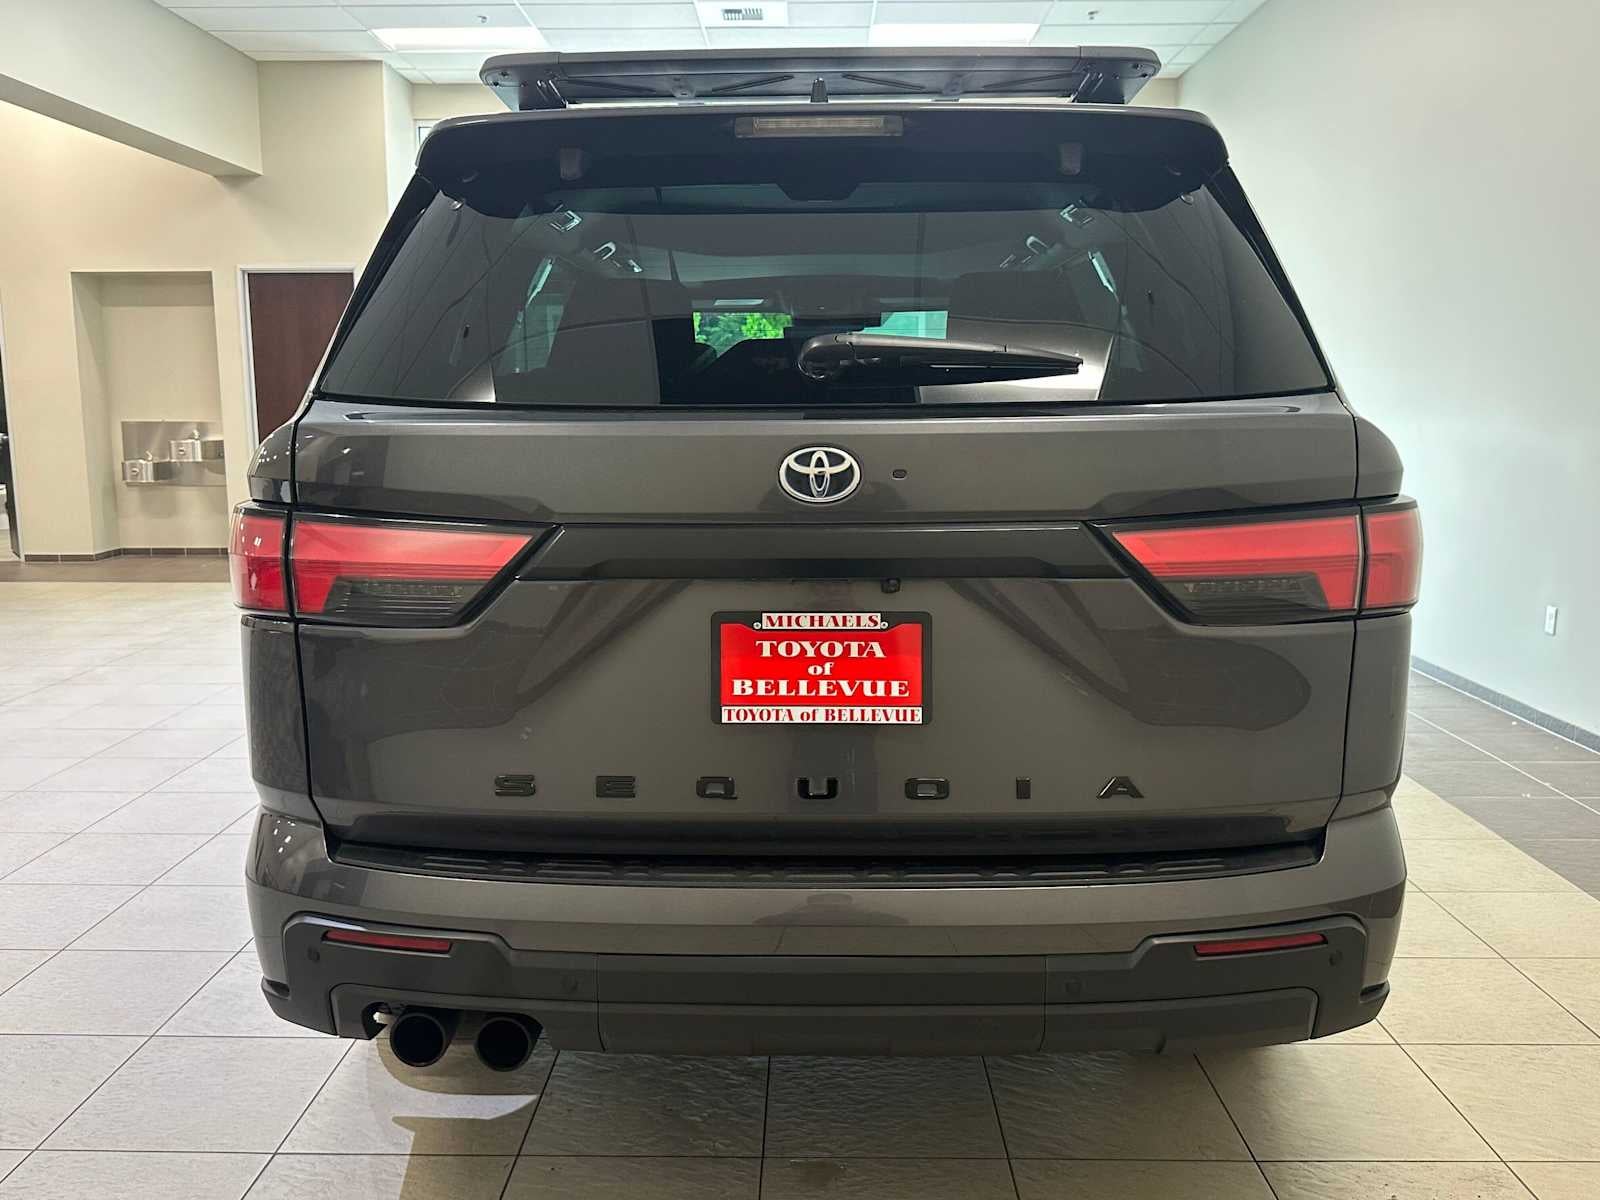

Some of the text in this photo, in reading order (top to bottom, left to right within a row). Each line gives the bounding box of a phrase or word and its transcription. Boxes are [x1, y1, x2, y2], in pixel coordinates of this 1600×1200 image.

[765, 615, 880, 628] MICHAELS
[755, 640, 887, 658] TOYOTA
[807, 662, 835, 676] of
[732, 679, 910, 697] BELLEVUE
[723, 708, 921, 722] TOYOTA of BELLEVUE
[495, 774, 1145, 800] SEQUOIA
